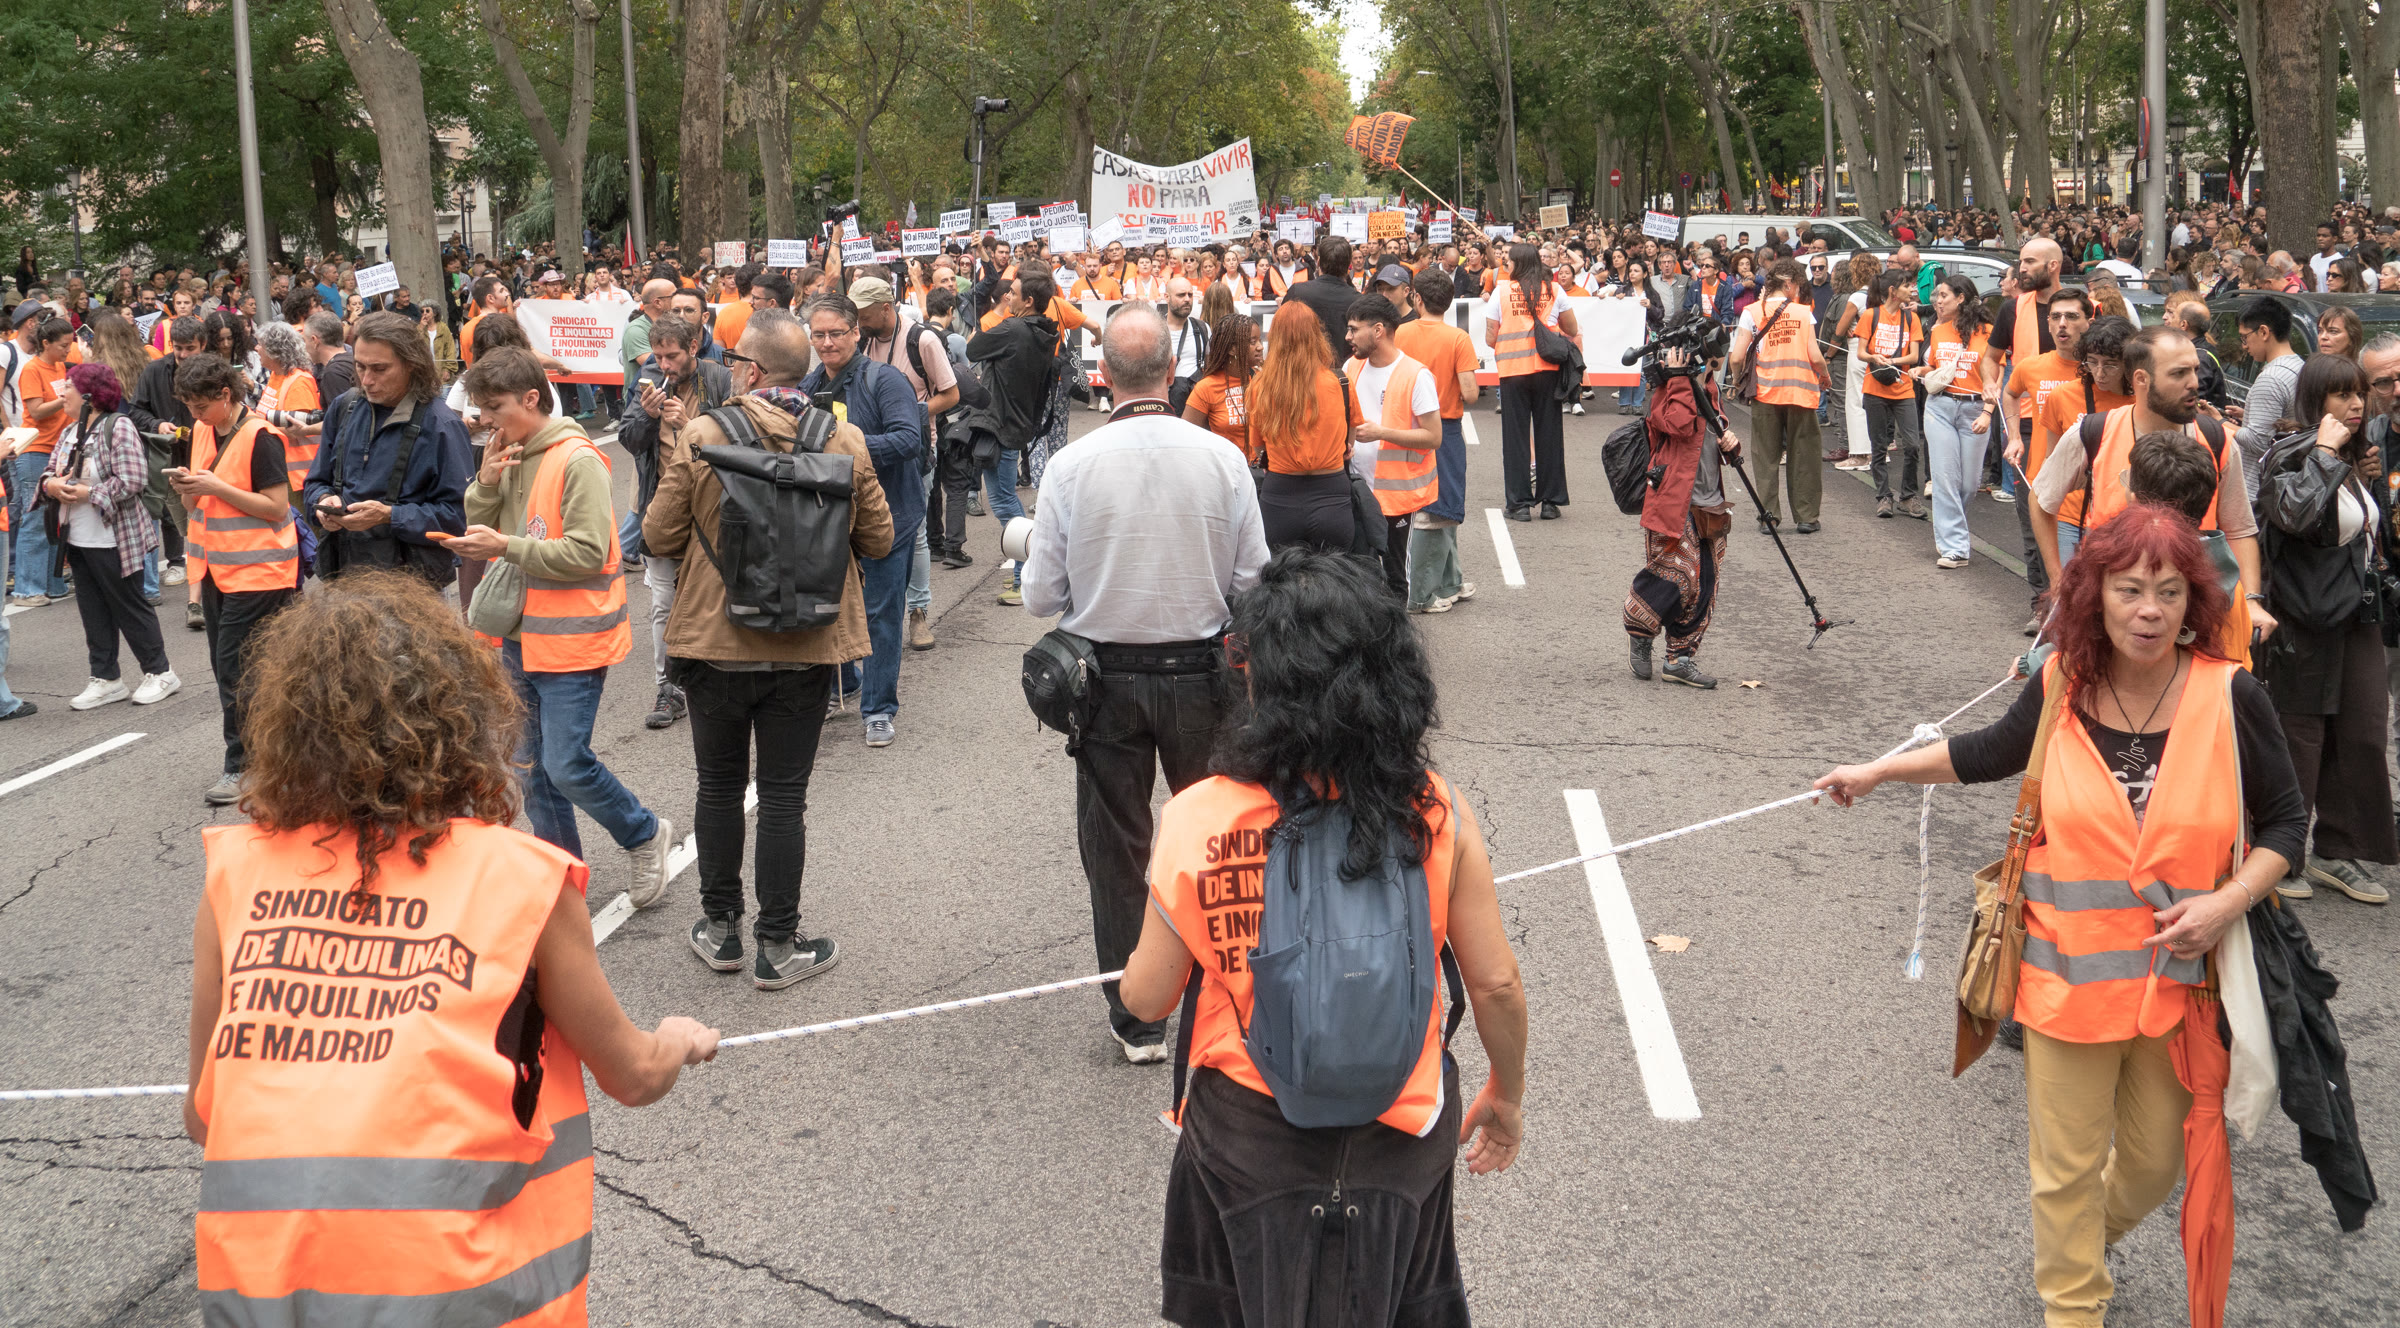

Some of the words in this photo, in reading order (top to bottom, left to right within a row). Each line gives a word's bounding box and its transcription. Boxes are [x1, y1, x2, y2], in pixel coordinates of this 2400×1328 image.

[1386, 120, 1408, 158] MADRID
[1092, 150, 1154, 183] CASAS
[1158, 164, 1206, 185] PARA
[1128, 183, 1156, 209] NO
[1160, 185, 1211, 209] PARA
[942, 212, 970, 221] DERECHO
[947, 219, 969, 228] TECHO
[1043, 218, 1053, 228] LO
[918, 231, 939, 240] FRAUDE
[1168, 236, 1177, 245] LO
[552, 315, 597, 326] SINDICATO
[552, 327, 563, 336] DE
[564, 327, 612, 338] INQUILINAS
[552, 339, 557, 347] E
[558, 338, 606, 348] INQUILINOS
[552, 348, 563, 357] DE
[564, 348, 599, 358] MADRID
[1133, 404, 1165, 412] Canon
[1229, 408, 1233, 416] E
[1229, 416, 1238, 425] DE
[1205, 871, 1235, 905] DE
[250, 888, 428, 930] SINDICATO
[1207, 914, 1222, 943] E
[236, 930, 282, 969] DE
[281, 930, 469, 981] INQUILINAS
[228, 980, 245, 1014] E
[246, 978, 441, 1021] INQUILINOS
[215, 1022, 256, 1060] DE
[260, 1023, 394, 1063] MADRID
